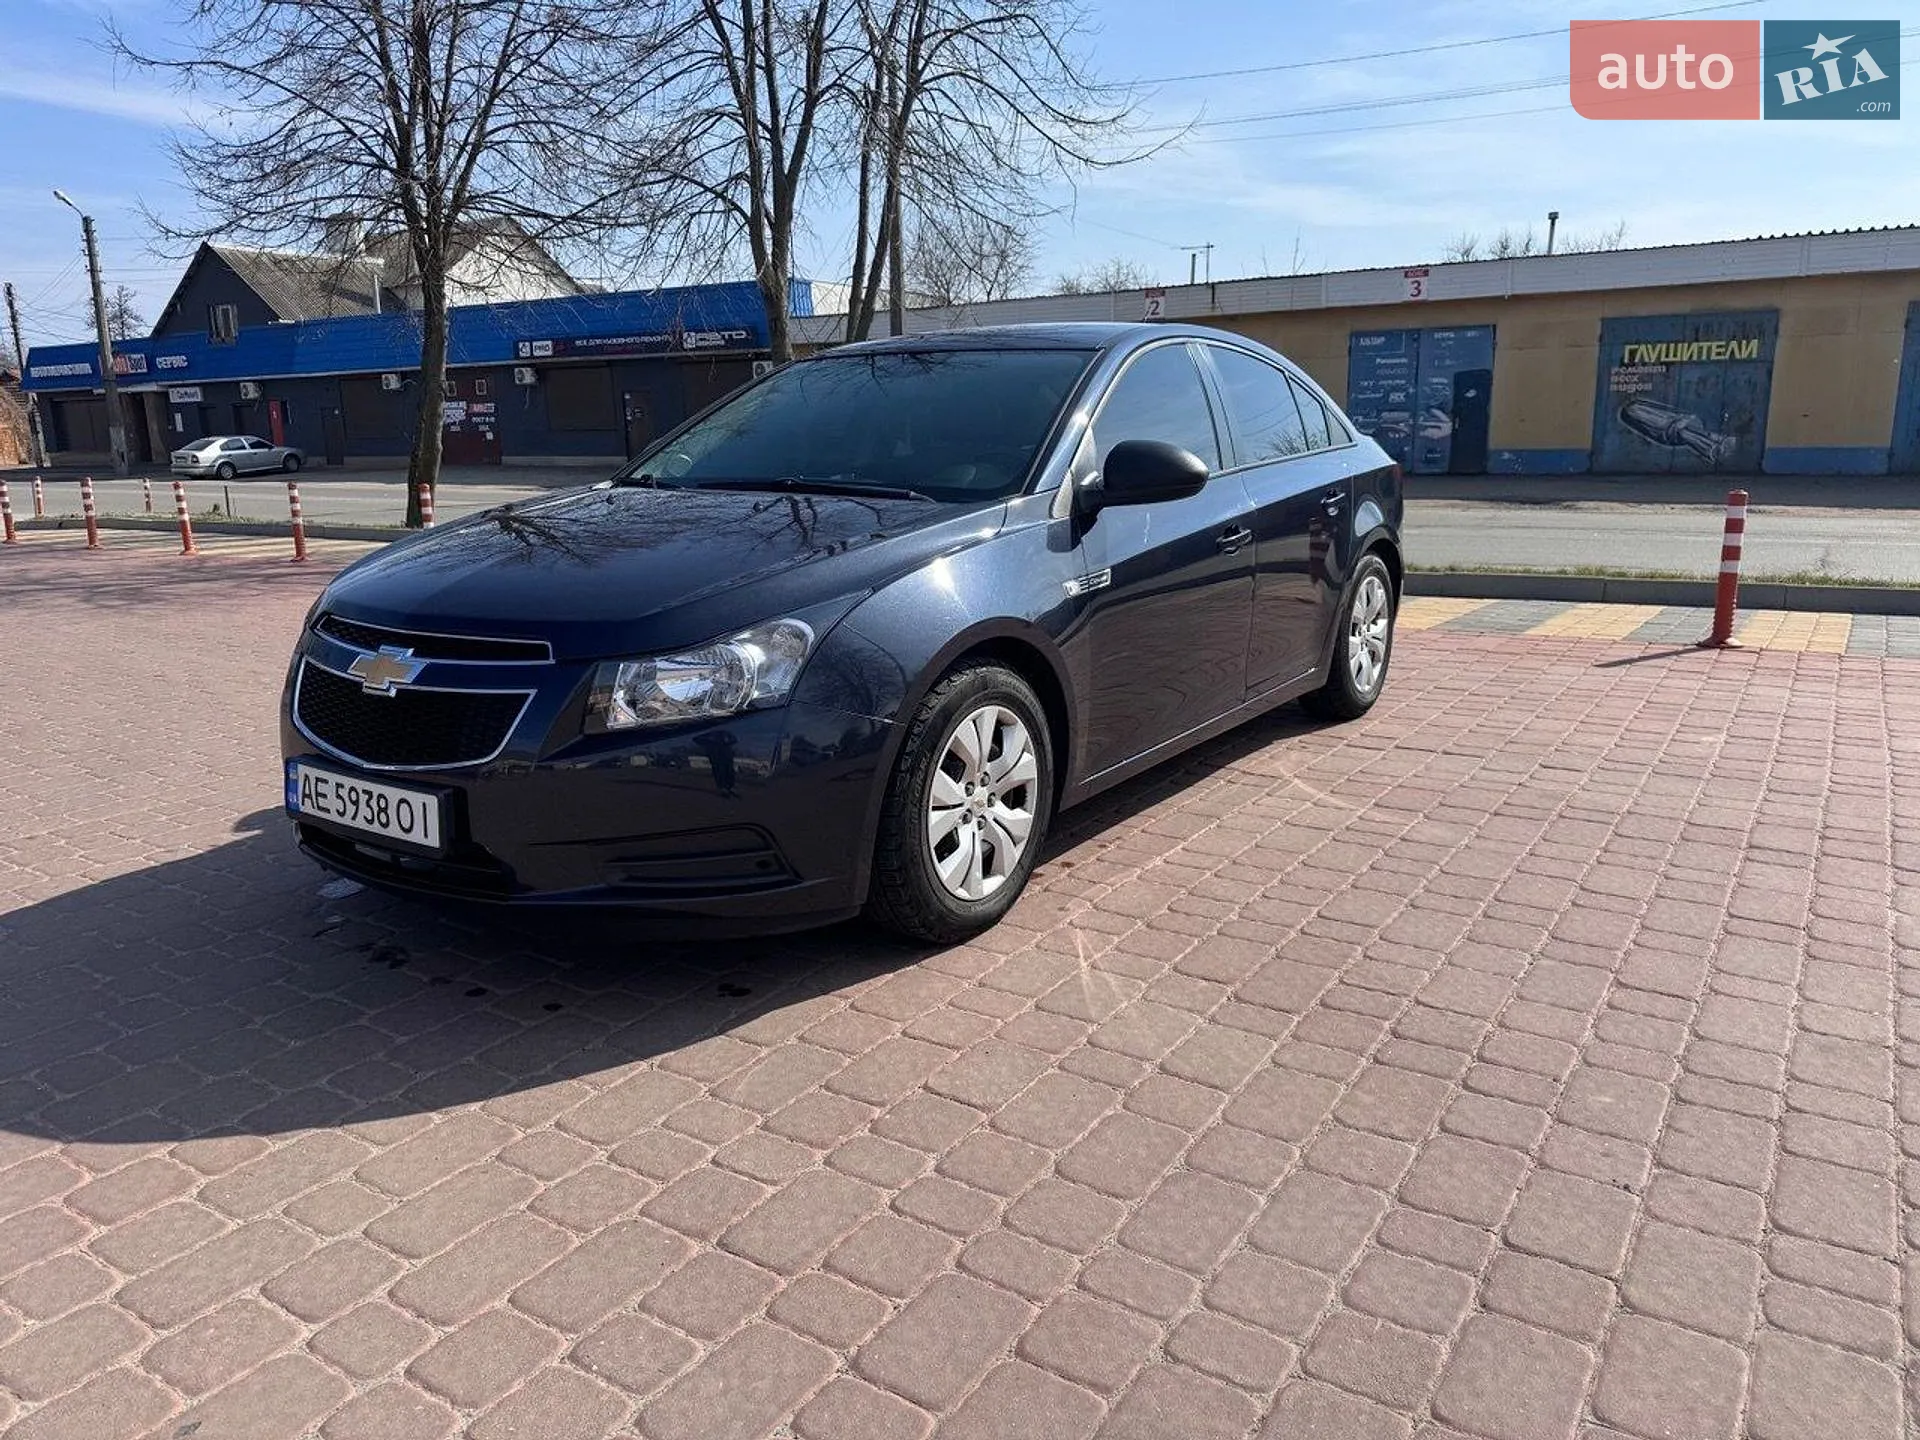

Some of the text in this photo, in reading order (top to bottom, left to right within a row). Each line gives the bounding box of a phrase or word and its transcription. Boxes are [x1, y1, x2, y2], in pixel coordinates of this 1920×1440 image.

[1410, 280, 1421, 297] 3
[1150, 300, 1160, 316] 2
[1623, 339, 1759, 364] ГЛУШИТЕЛИ
